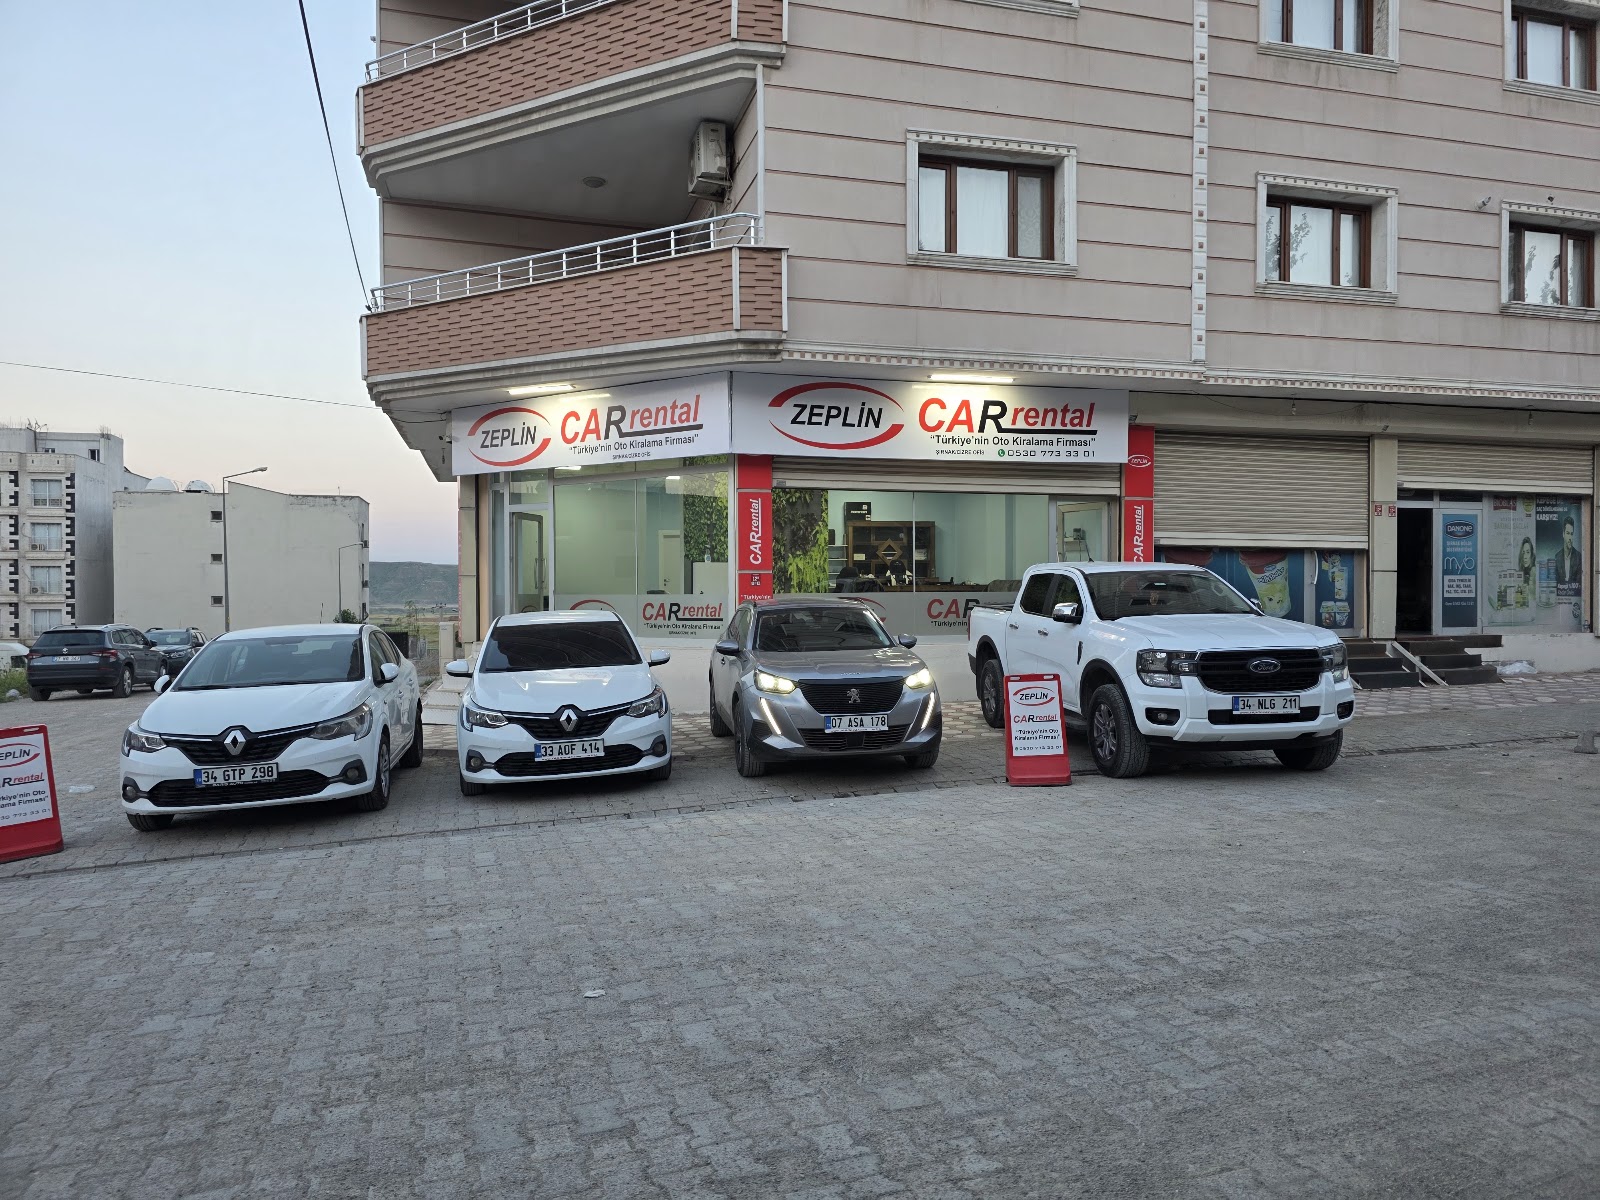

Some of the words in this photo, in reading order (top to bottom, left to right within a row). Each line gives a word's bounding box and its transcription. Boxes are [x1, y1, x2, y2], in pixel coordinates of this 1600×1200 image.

[790, 401, 883, 429] ZEPLİN
[480, 421, 537, 449] ZEPLİN
[614, 441, 628, 450] Oto
[629, 439, 663, 449] Kiralama
[992, 436, 1010, 446] Oto
[1012, 436, 1054, 447] Kiralama
[1019, 691, 1048, 701] ZEPLİN
[1240, 698, 1252, 710] 34
[1257, 698, 1276, 710] NLG
[1282, 698, 1297, 709] 211
[831, 717, 843, 728] 07
[848, 717, 865, 728] ASA
[870, 716, 886, 726] 178
[0, 748, 31, 761] EPLİN
[541, 745, 554, 757] 33
[557, 743, 577, 756] AOF
[581, 742, 600, 753] 414
[202, 770, 217, 783] 34
[222, 767, 245, 782] GTP
[251, 765, 274, 779] 298
[0, 801, 16, 809] ama
